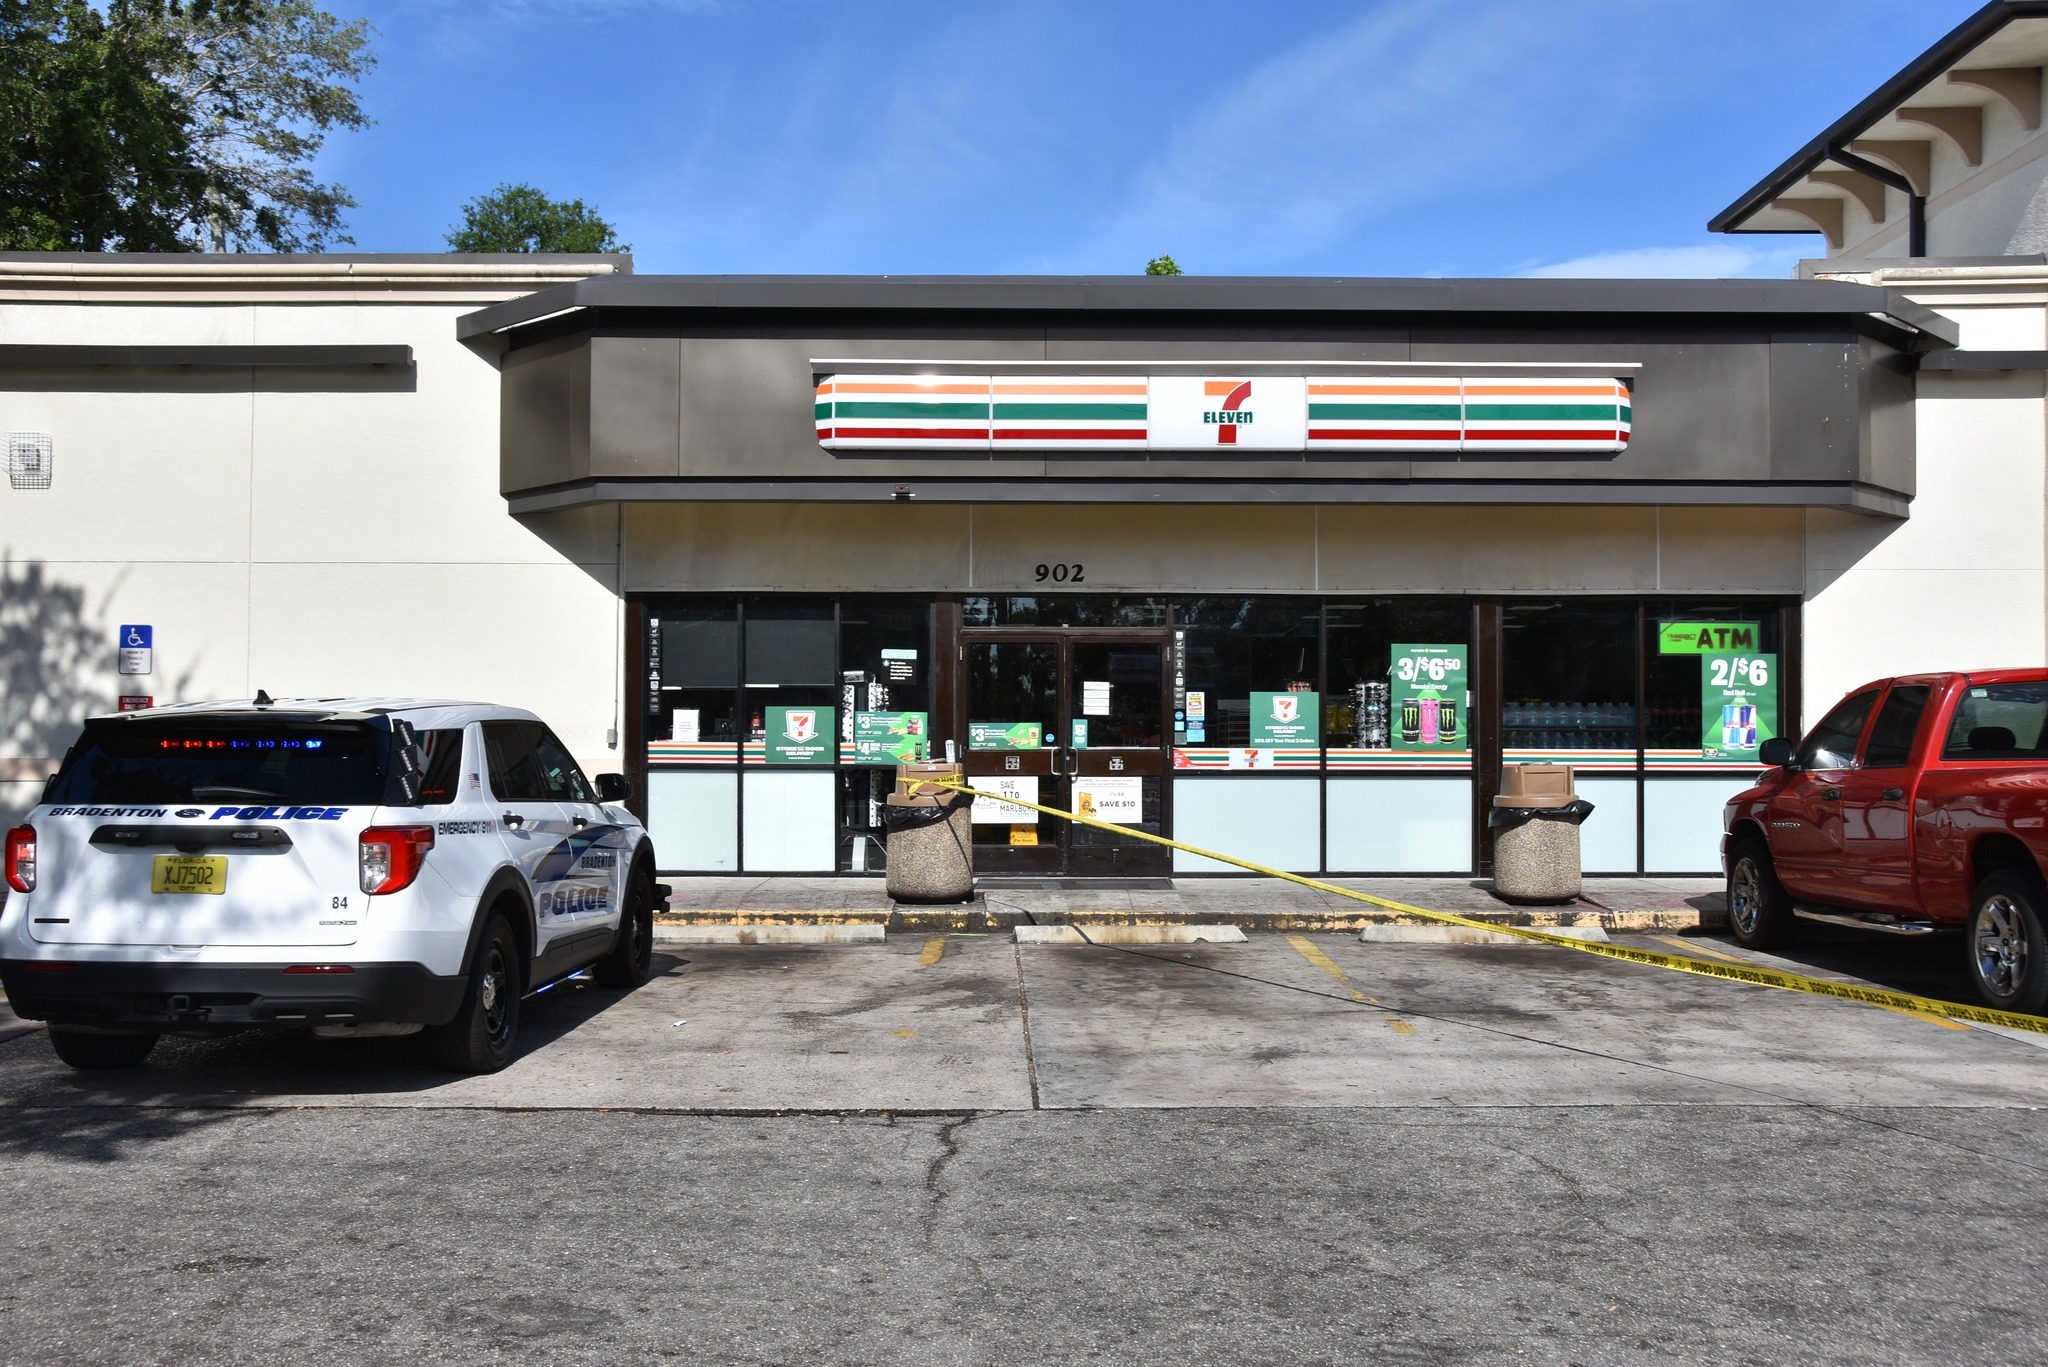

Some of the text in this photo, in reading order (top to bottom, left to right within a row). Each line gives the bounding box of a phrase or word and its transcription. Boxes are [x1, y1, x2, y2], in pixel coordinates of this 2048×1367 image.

[1204, 380, 1252, 444] 7
[1035, 563, 1085, 582] 902
[1696, 628, 1752, 649] ATM
[1711, 657, 1768, 688] 2/$6
[857, 715, 871, 729] $3
[970, 728, 985, 742] $3
[857, 741, 870, 755] $4
[1000, 780, 1014, 789] SAVE
[48, 806, 350, 820] BRADENTON POLICE
[438, 821, 481, 835] EMERGENCY
[581, 855, 616, 868] BRADENTON
[163, 866, 214, 884] XJ7502
[332, 896, 348, 909] 84
[539, 886, 609, 918] POLICE
[1690, 961, 1786, 987] CRIME SCENE DO NOT CROSS
[1808, 981, 1917, 1010] CRIME SCENE DO NOT CROSS
[1942, 1005, 1974, 1020] CROSS
